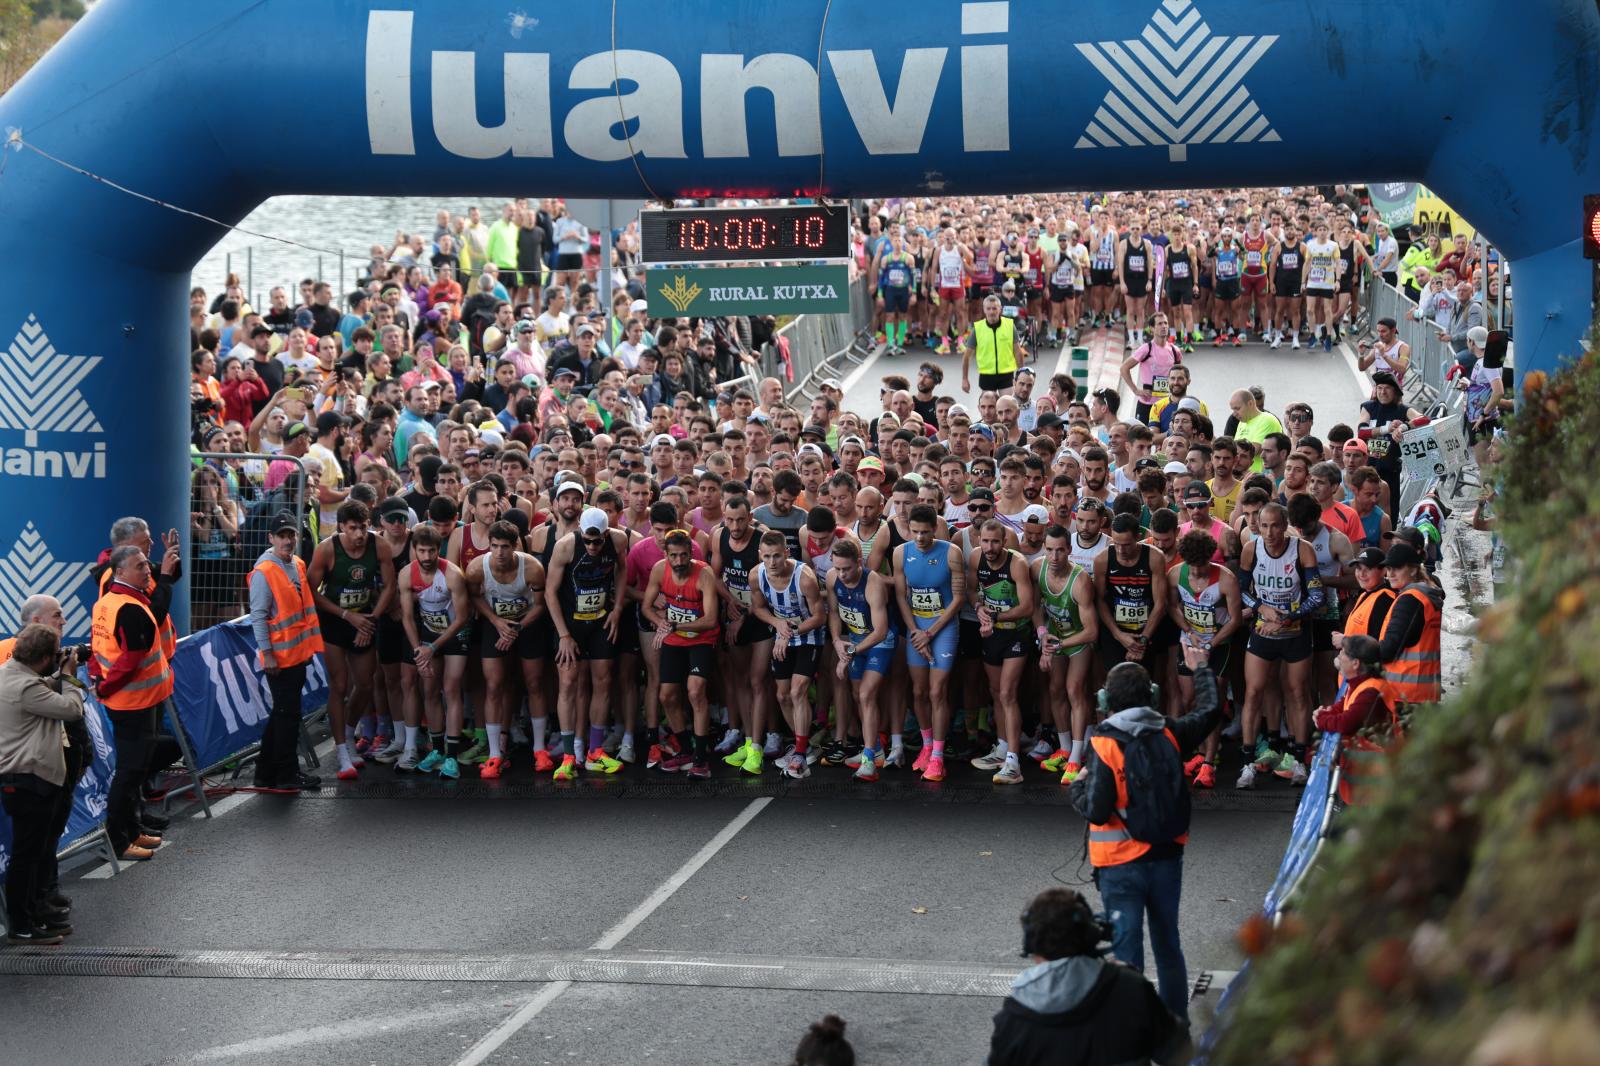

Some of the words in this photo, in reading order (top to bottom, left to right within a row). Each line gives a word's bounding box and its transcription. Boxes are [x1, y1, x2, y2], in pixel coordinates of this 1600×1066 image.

[365, 1, 1010, 161] luanvi
[709, 286, 769, 302] RURAL
[773, 284, 838, 300] KUTXA
[1370, 440, 1388, 449] 194
[1402, 440, 1426, 456] 331
[0, 442, 106, 478] anvi
[585, 595, 600, 606] 42
[916, 594, 932, 605] 24
[670, 611, 692, 623] 375
[842, 610, 856, 622] 23
[1120, 607, 1145, 618] 186
[1186, 608, 1209, 621] 317
